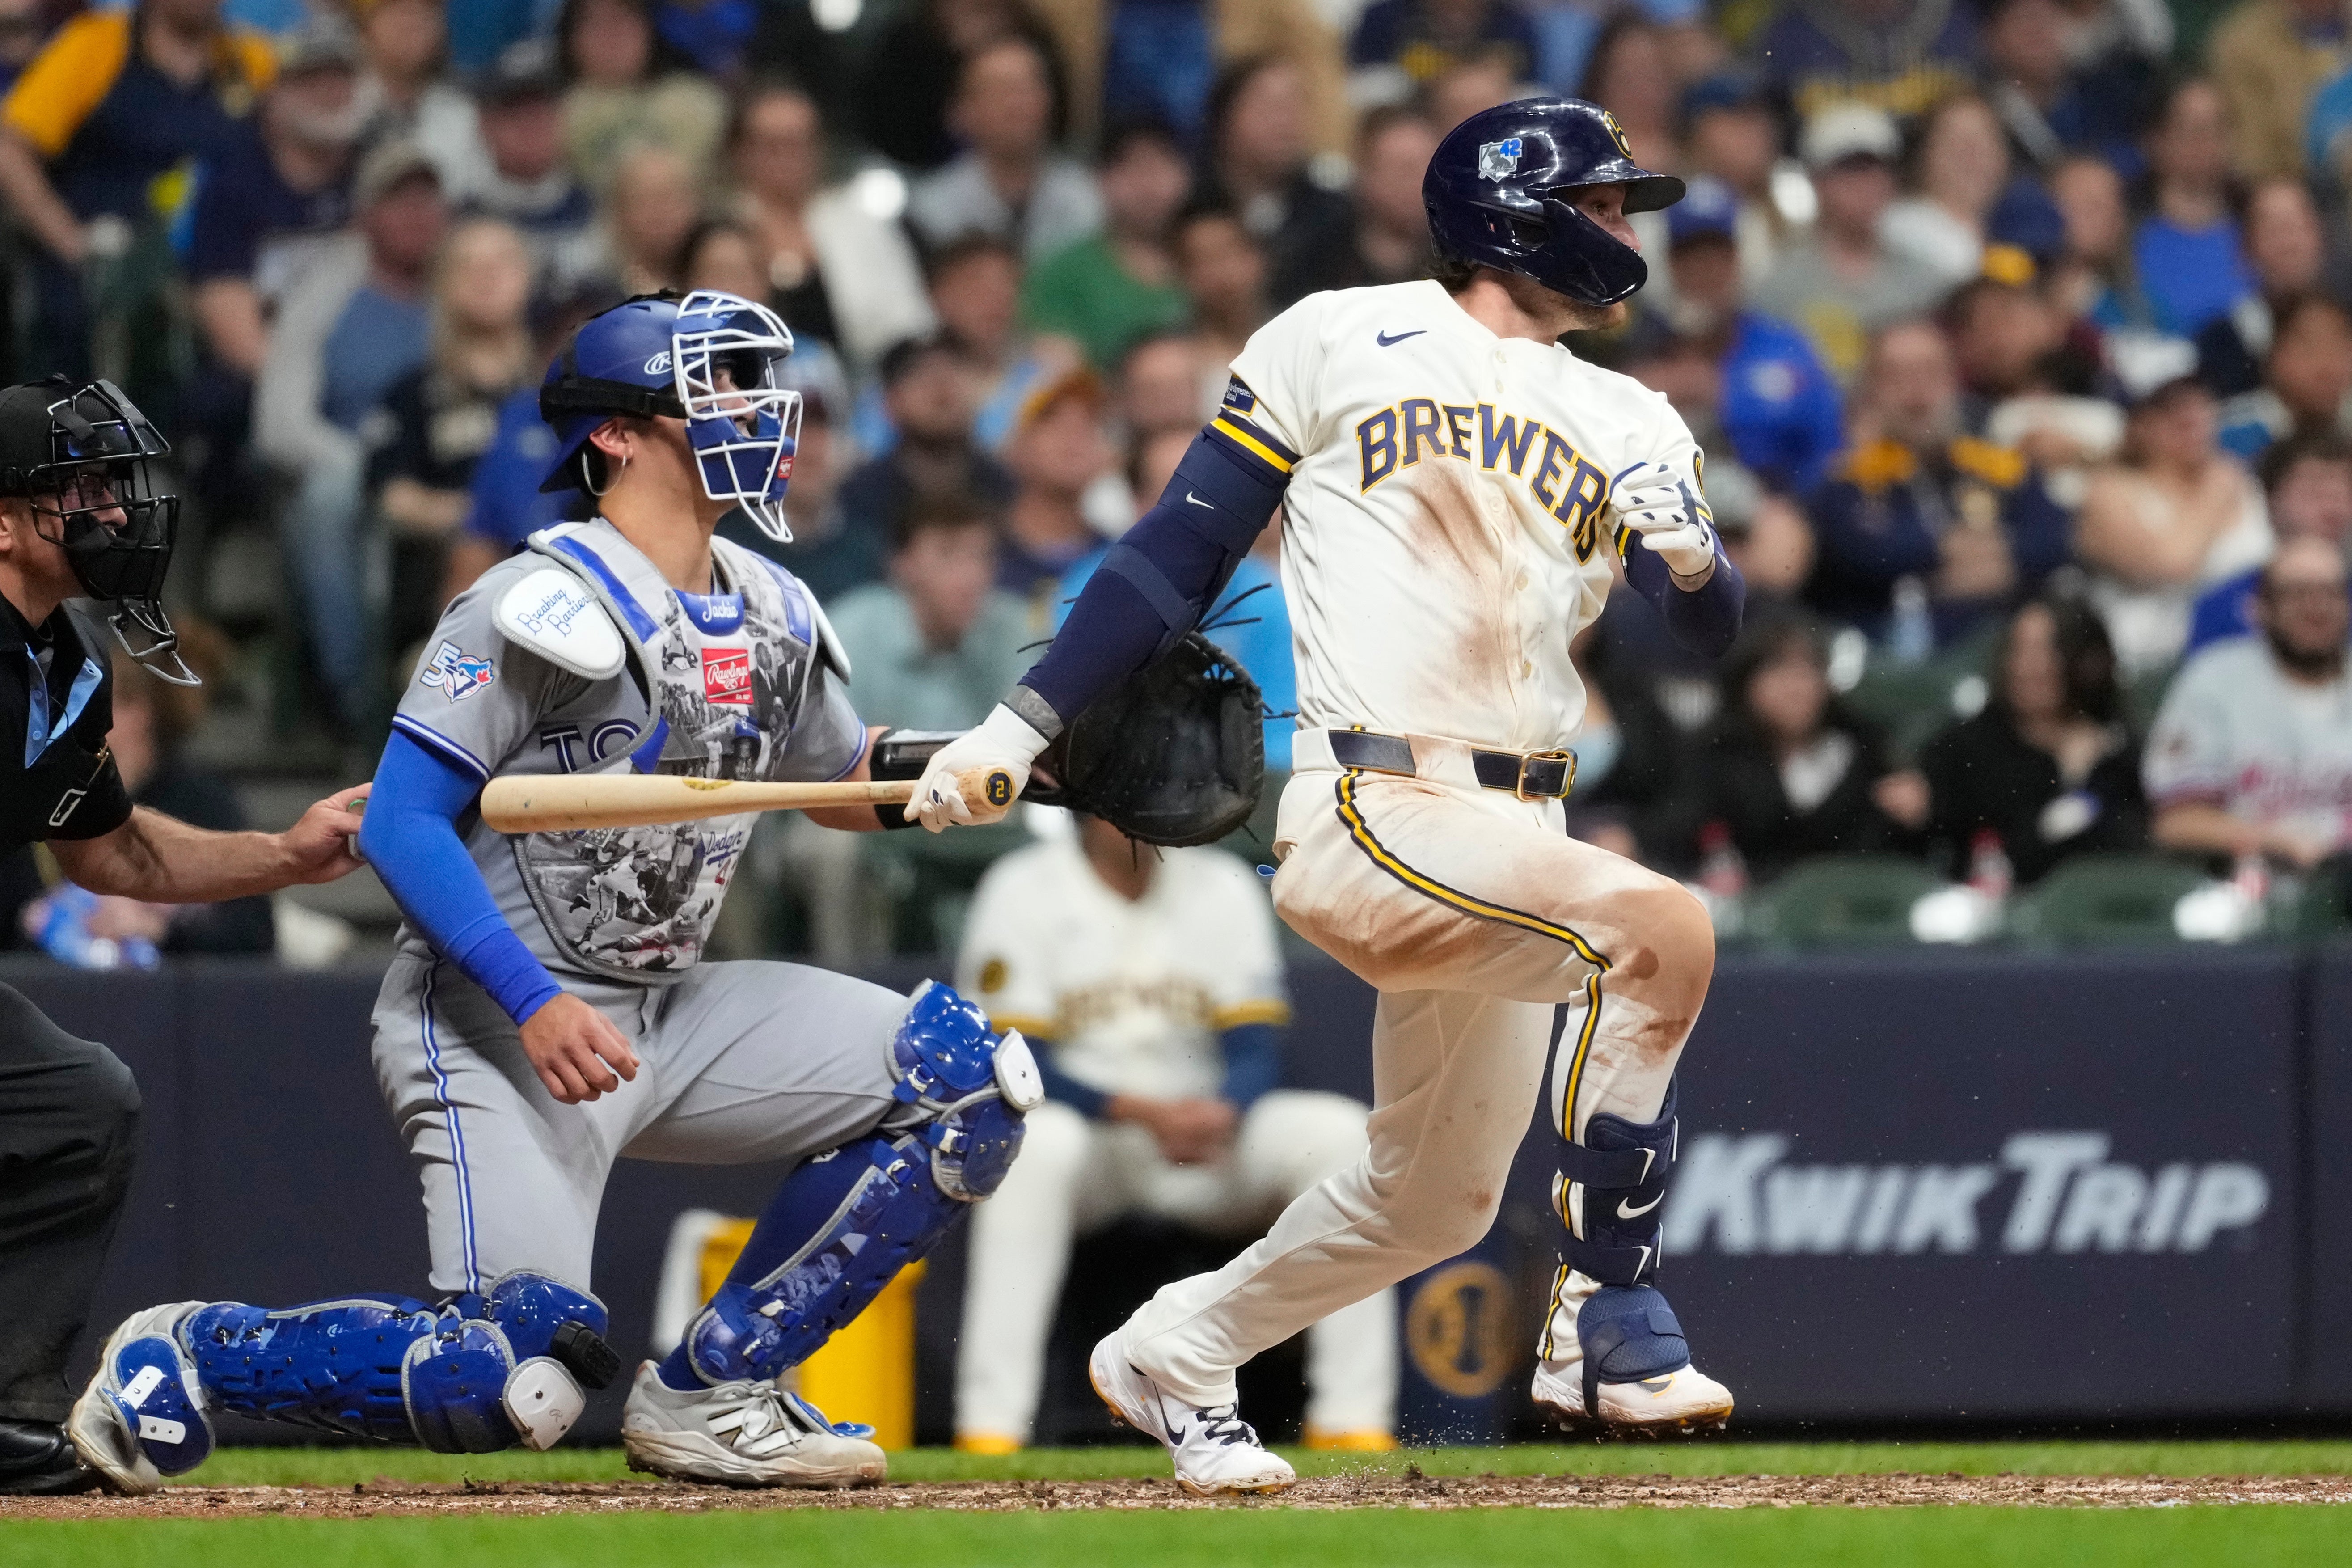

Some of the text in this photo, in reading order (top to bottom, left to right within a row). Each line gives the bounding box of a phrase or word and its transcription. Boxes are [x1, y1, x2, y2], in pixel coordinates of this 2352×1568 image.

[1499, 139, 1521, 156] 42
[515, 588, 571, 636] Breaking
[545, 595, 591, 638] Barrier
[699, 595, 738, 623] Jackie
[707, 661, 748, 686] Rawlings
[996, 780, 1005, 798] 2
[1662, 1131, 2271, 1255] KWIK TRIP
